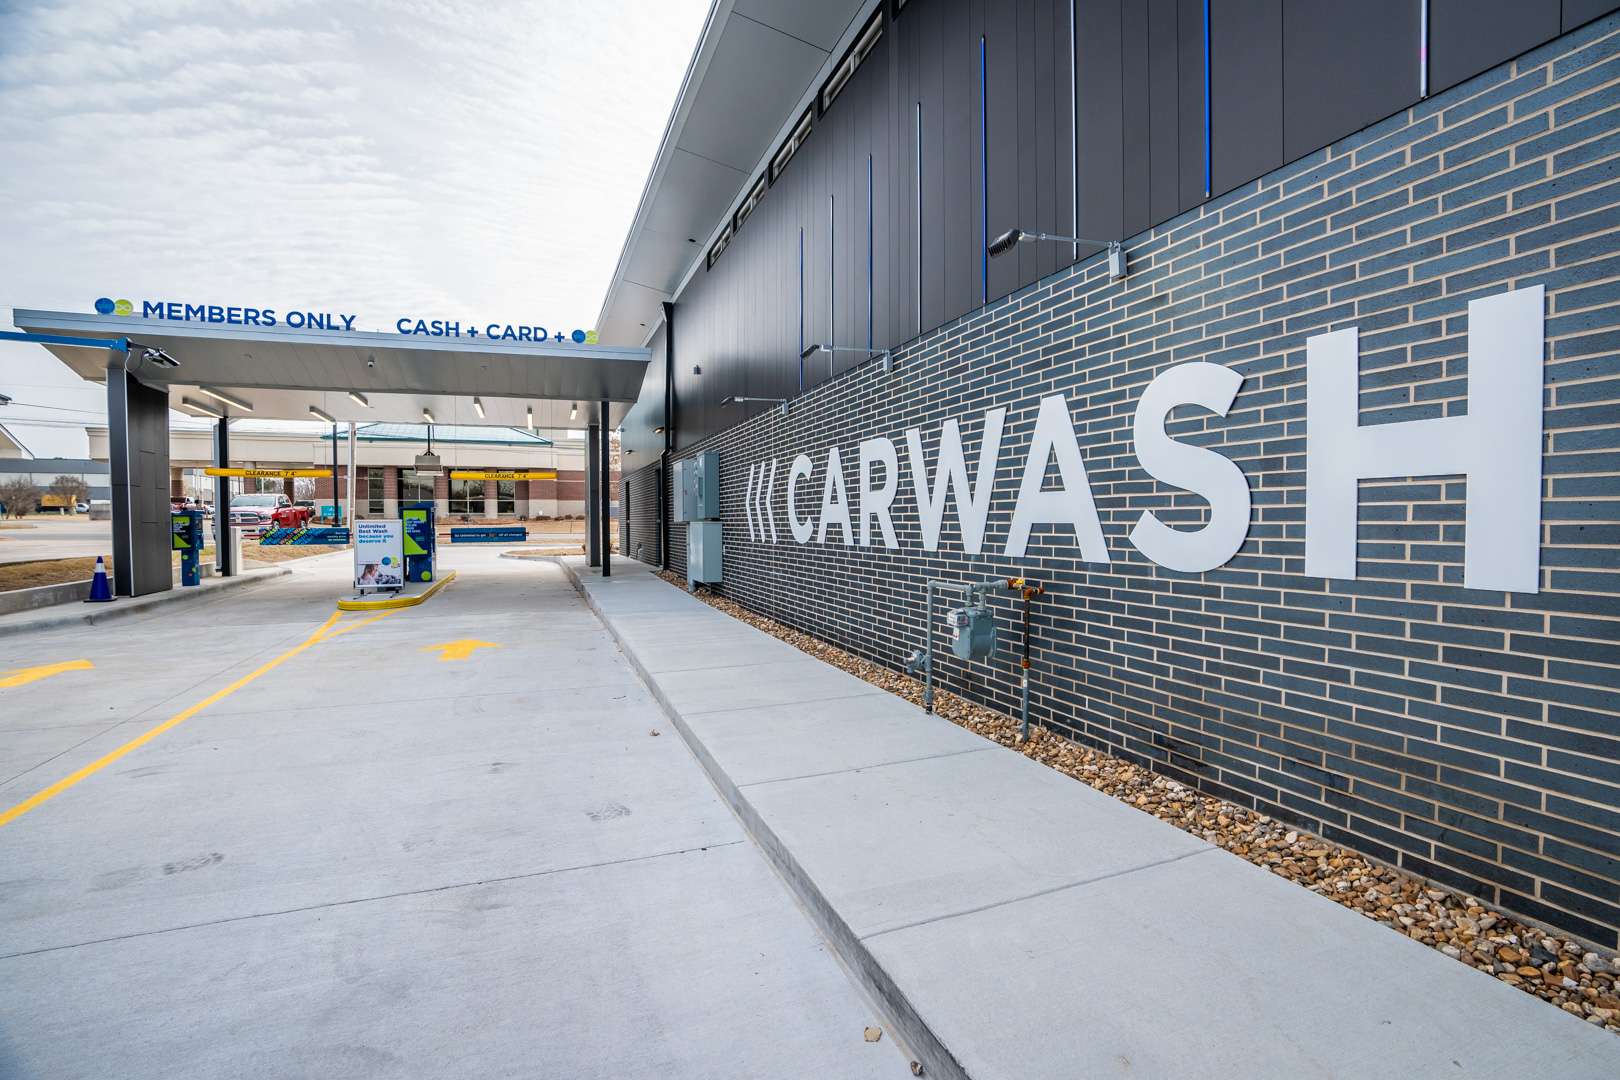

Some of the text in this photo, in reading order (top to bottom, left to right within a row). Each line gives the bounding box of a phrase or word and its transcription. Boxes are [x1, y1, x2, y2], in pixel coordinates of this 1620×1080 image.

[142, 300, 357, 332] MEMBERS ONLY
[396, 317, 460, 338] CASH
[486, 324, 548, 343] CARD
[787, 284, 1545, 594] CARWASH
[244, 469, 282, 478] CLEARANCE
